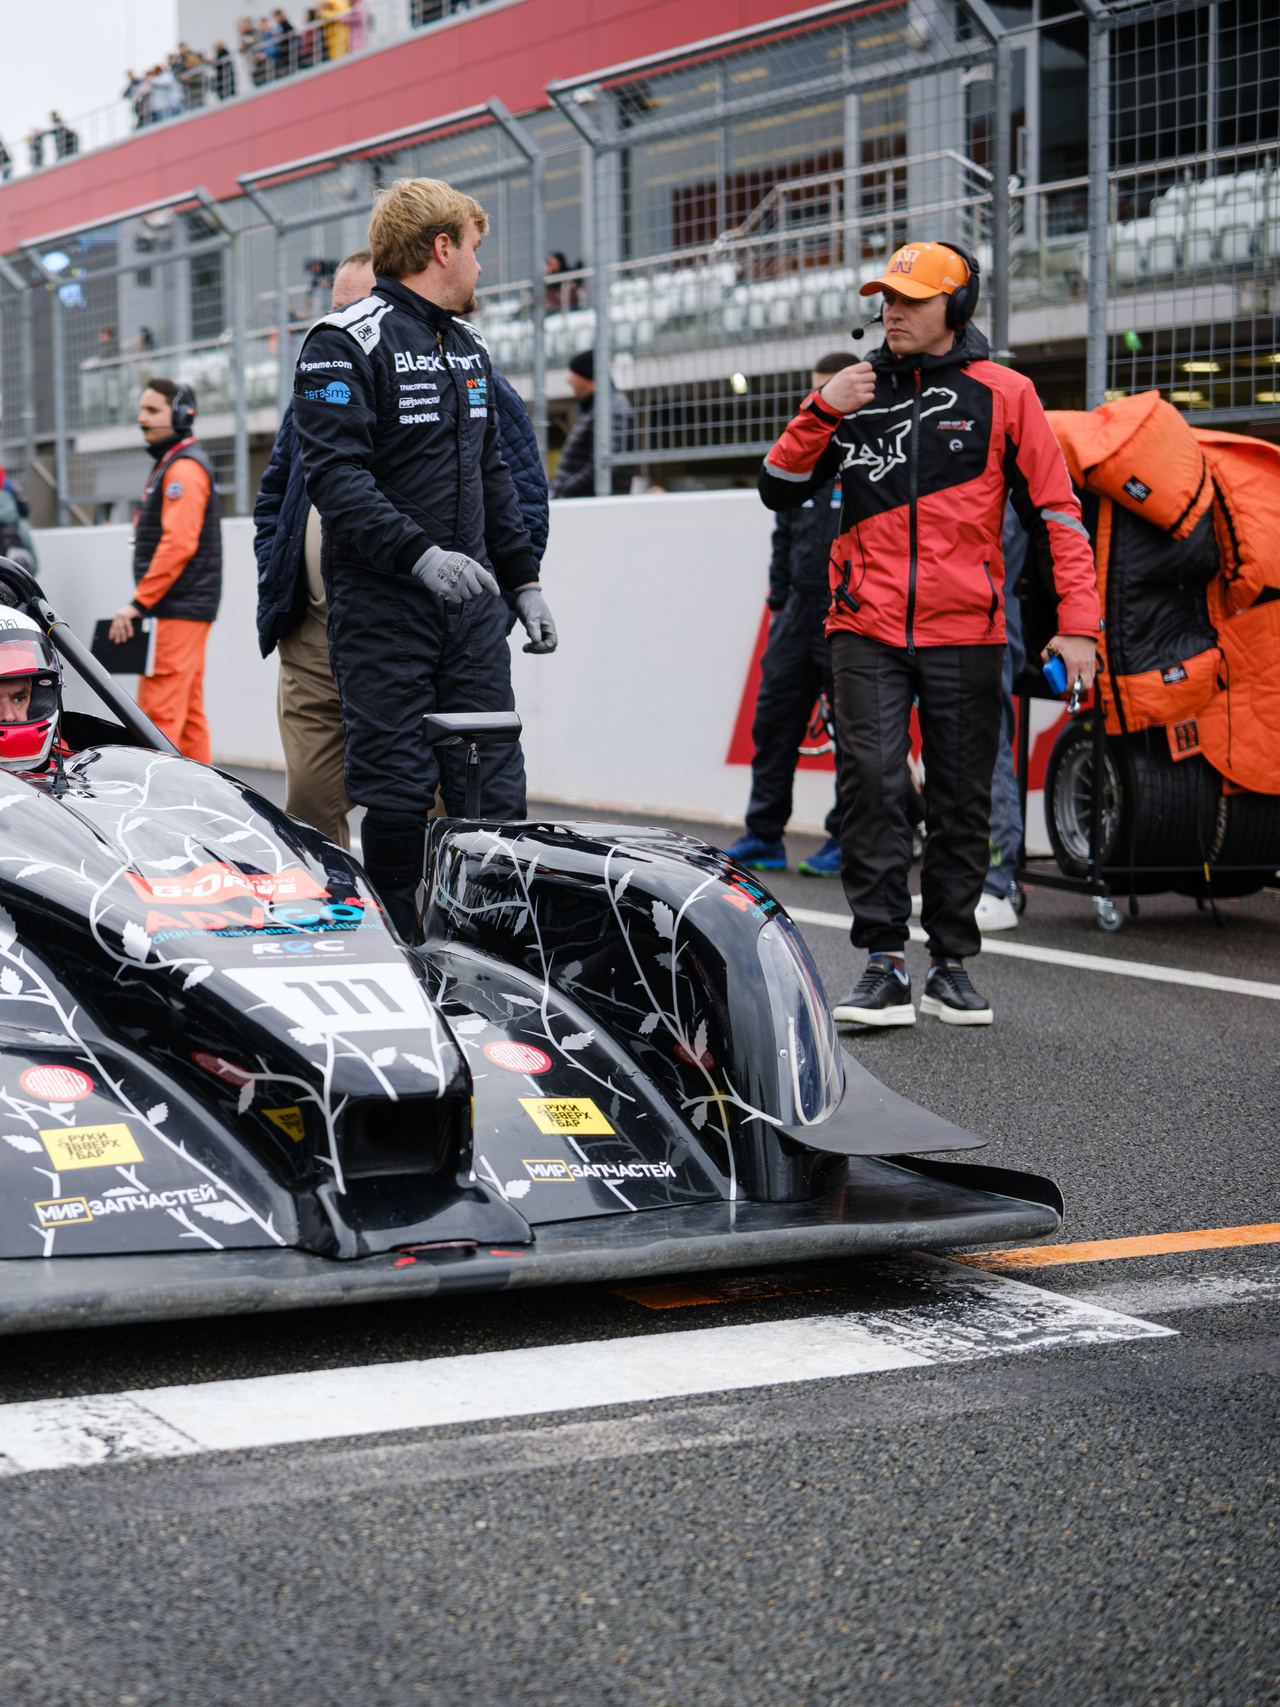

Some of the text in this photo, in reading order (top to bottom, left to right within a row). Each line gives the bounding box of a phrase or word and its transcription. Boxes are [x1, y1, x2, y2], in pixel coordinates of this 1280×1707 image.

[307, 360, 352, 371] game.com
[304, 388, 351, 400] terasms
[152, 921, 381, 945] digital marketing solutions
[283, 977, 405, 1016] 111
[545, 1104, 580, 1112] РУКИ
[552, 1112, 593, 1120] ВВЕРХ
[68, 1132, 108, 1143] РУКИ
[73, 1139, 121, 1151] ВВЕРХ
[76, 1149, 105, 1160] БАР
[525, 1161, 677, 1178] МИР ЗАПЧАСТЕЙ
[36, 1183, 218, 1223] МИР ЗАПЧАСТЕЙ
